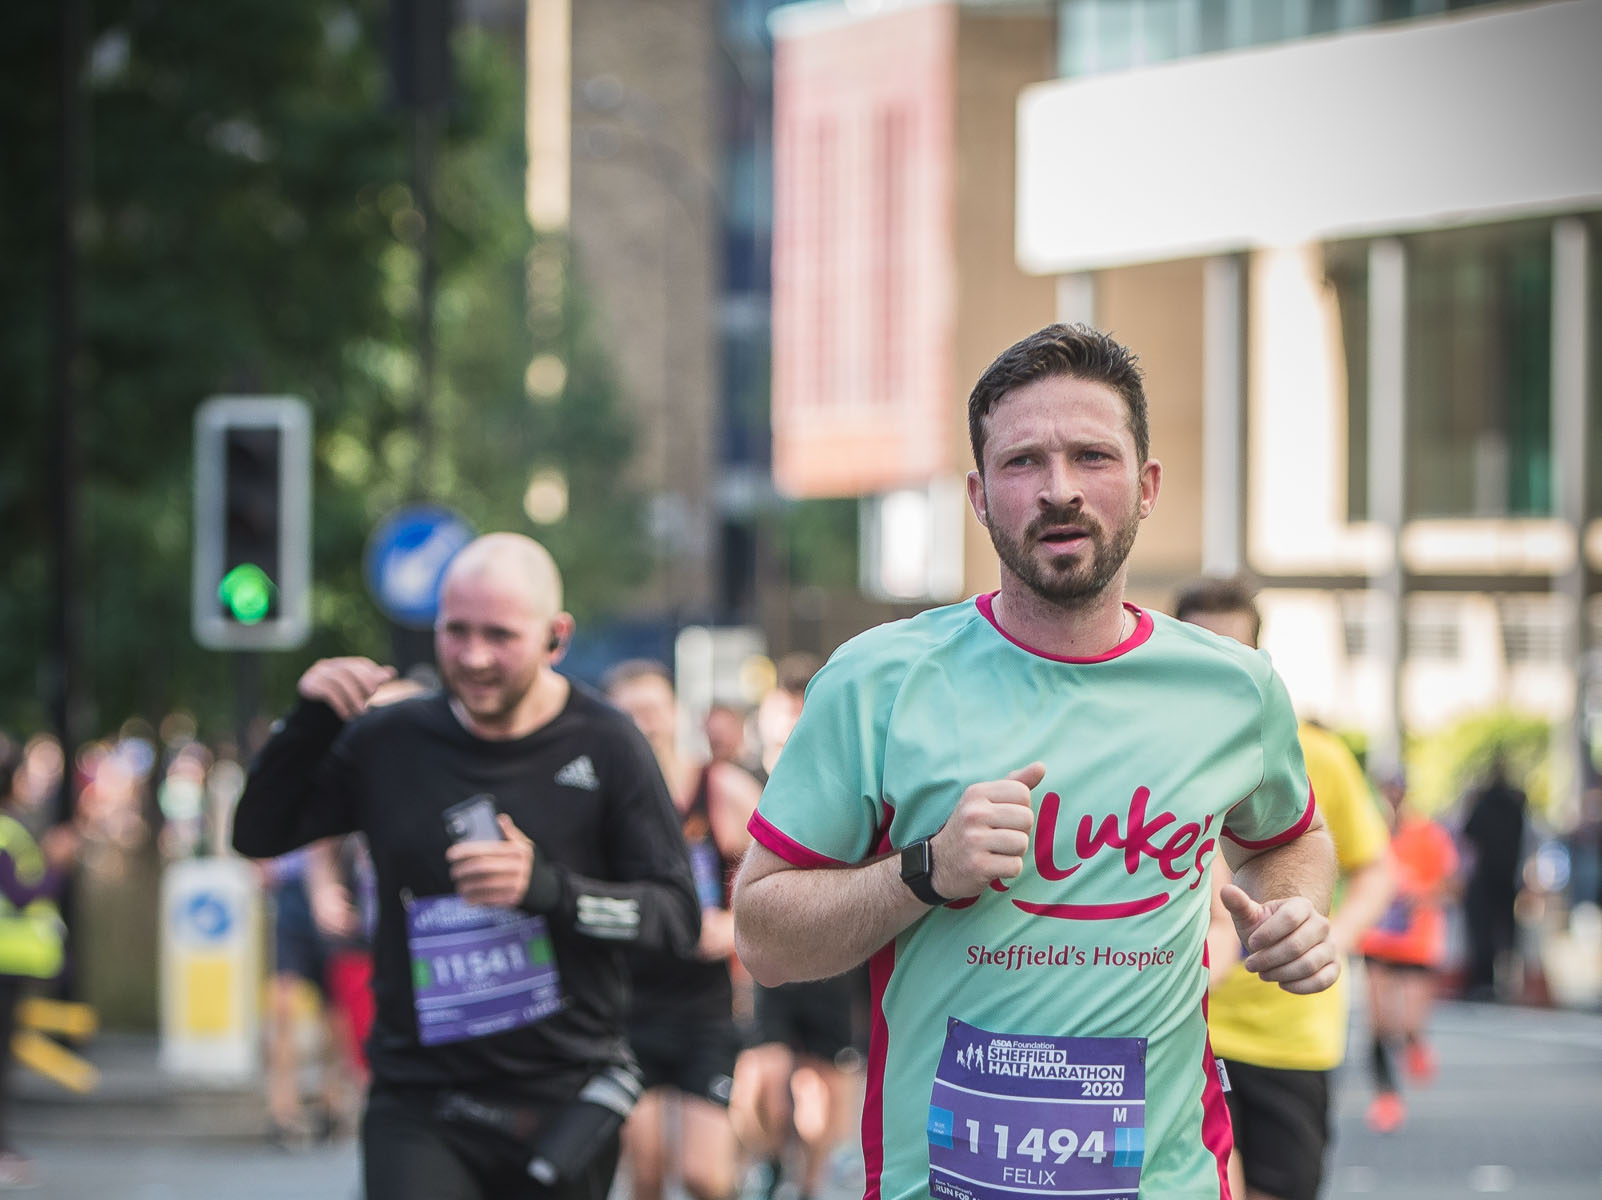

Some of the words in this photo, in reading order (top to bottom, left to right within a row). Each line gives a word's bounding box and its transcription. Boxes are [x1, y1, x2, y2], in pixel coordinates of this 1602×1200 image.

[1034, 786, 1214, 890] Luke's
[966, 945, 1086, 971] Sheffield's
[1093, 946, 1175, 972] Hospice
[990, 1039, 1012, 1048] ASDA
[1013, 1040, 1055, 1050] Foundation
[989, 1047, 1064, 1064] SHEFFIELD
[988, 1061, 1029, 1077] HALF
[1031, 1065, 1122, 1080] MARATHON
[1081, 1081, 1123, 1097] 2020
[1112, 1107, 1127, 1122] M
[966, 1118, 1107, 1164] 11494
[1003, 1166, 1056, 1186] FELIX
[935, 1184, 953, 1197] RUN
